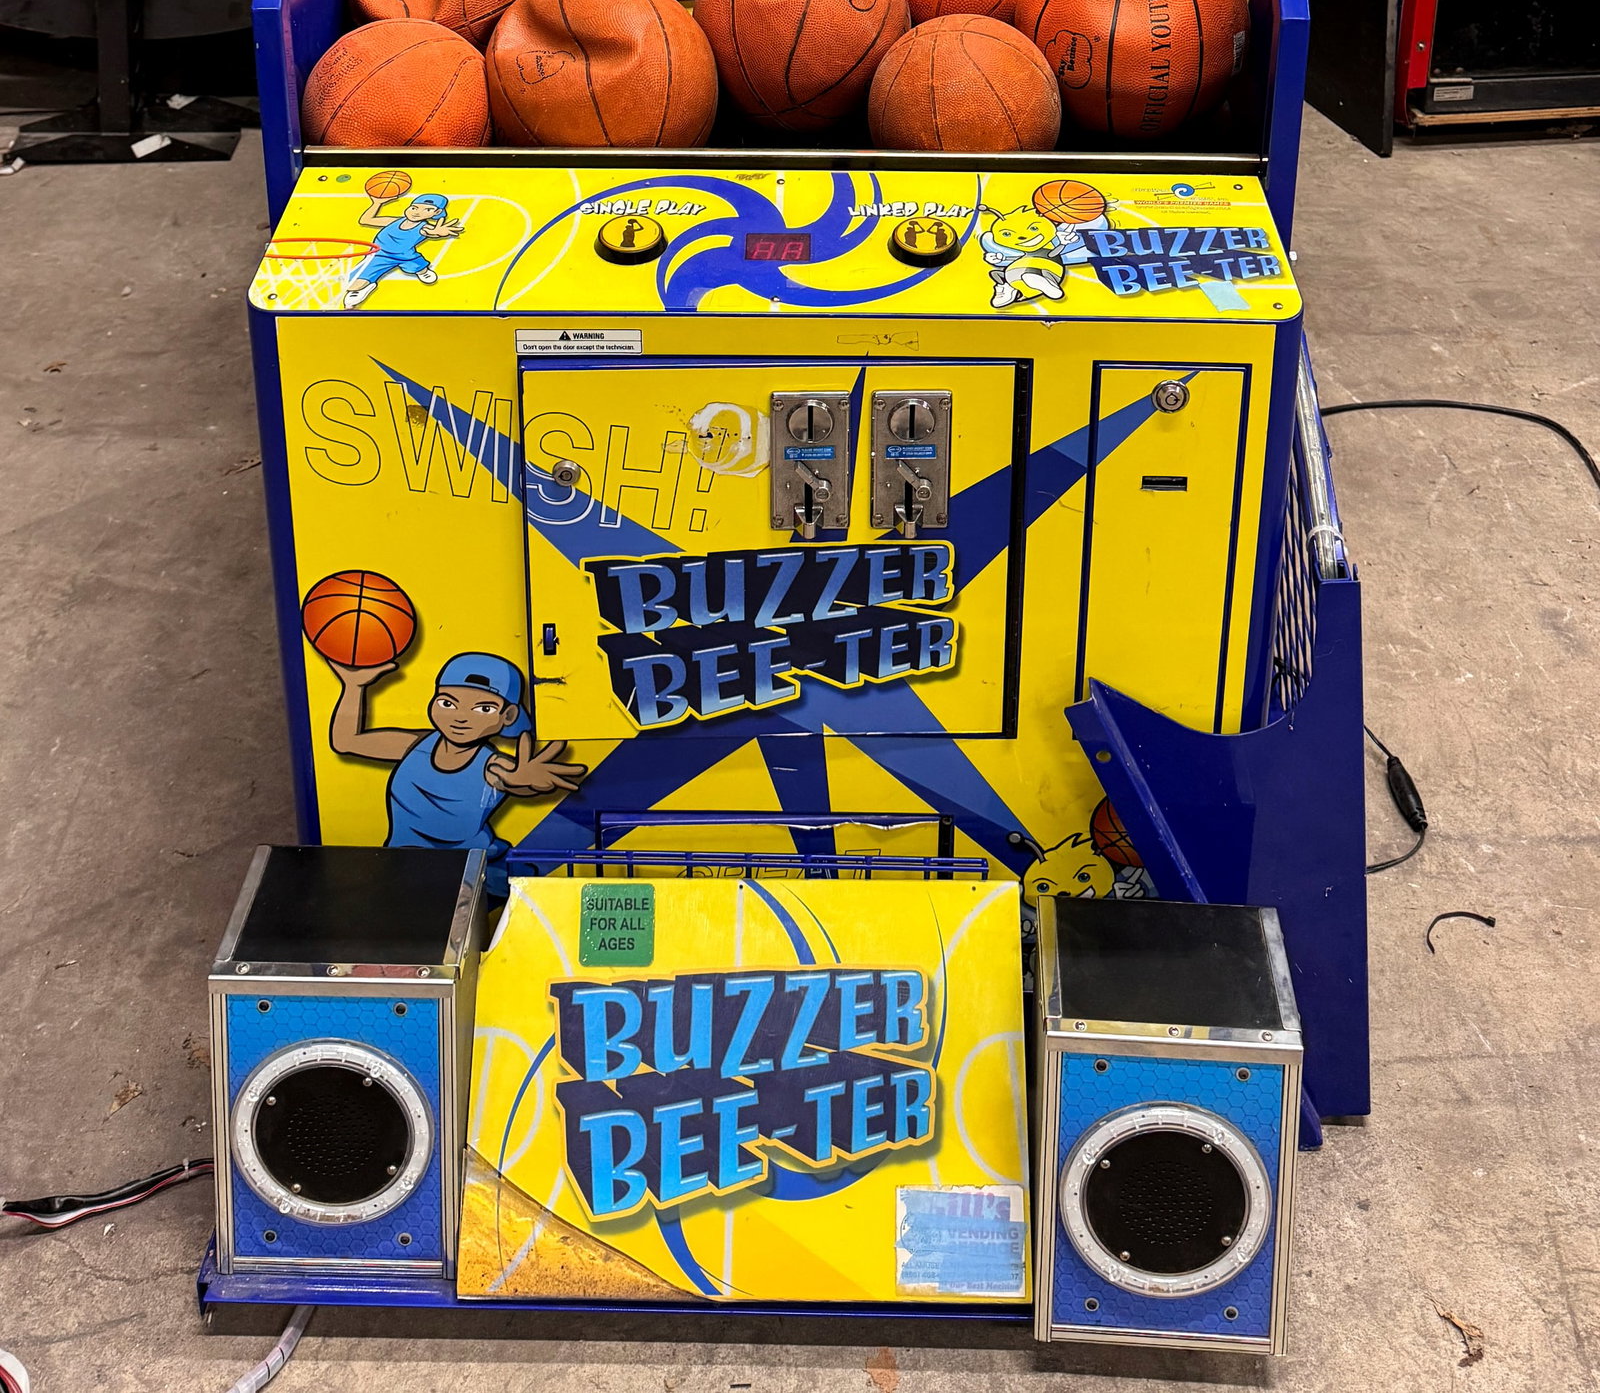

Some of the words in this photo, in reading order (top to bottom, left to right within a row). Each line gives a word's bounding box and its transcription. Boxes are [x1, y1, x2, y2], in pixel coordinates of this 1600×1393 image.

[1139, 59, 1171, 133] OFFICIAL
[579, 199, 651, 216] SINGLE
[655, 199, 706, 216] PLAY
[847, 202, 919, 217] LINKED
[924, 202, 975, 218] PLAY
[1086, 227, 1270, 258] BUZZER
[1100, 255, 1281, 296] BEE-TER
[572, 332, 605, 340] WARNING
[523, 343, 537, 351] Don't
[553, 343, 562, 351] the
[596, 343, 605, 351] the
[602, 544, 953, 639] BUZZER
[618, 617, 956, 727] BEE-TER
[586, 897, 650, 911] SUITABLE
[590, 917, 617, 931] FOR
[620, 917, 646, 931] ALL
[598, 937, 636, 951] AGES
[570, 970, 928, 1083] BUZZER
[577, 1068, 932, 1217] BEE-TER
[947, 1227, 1020, 1240] VENDING
